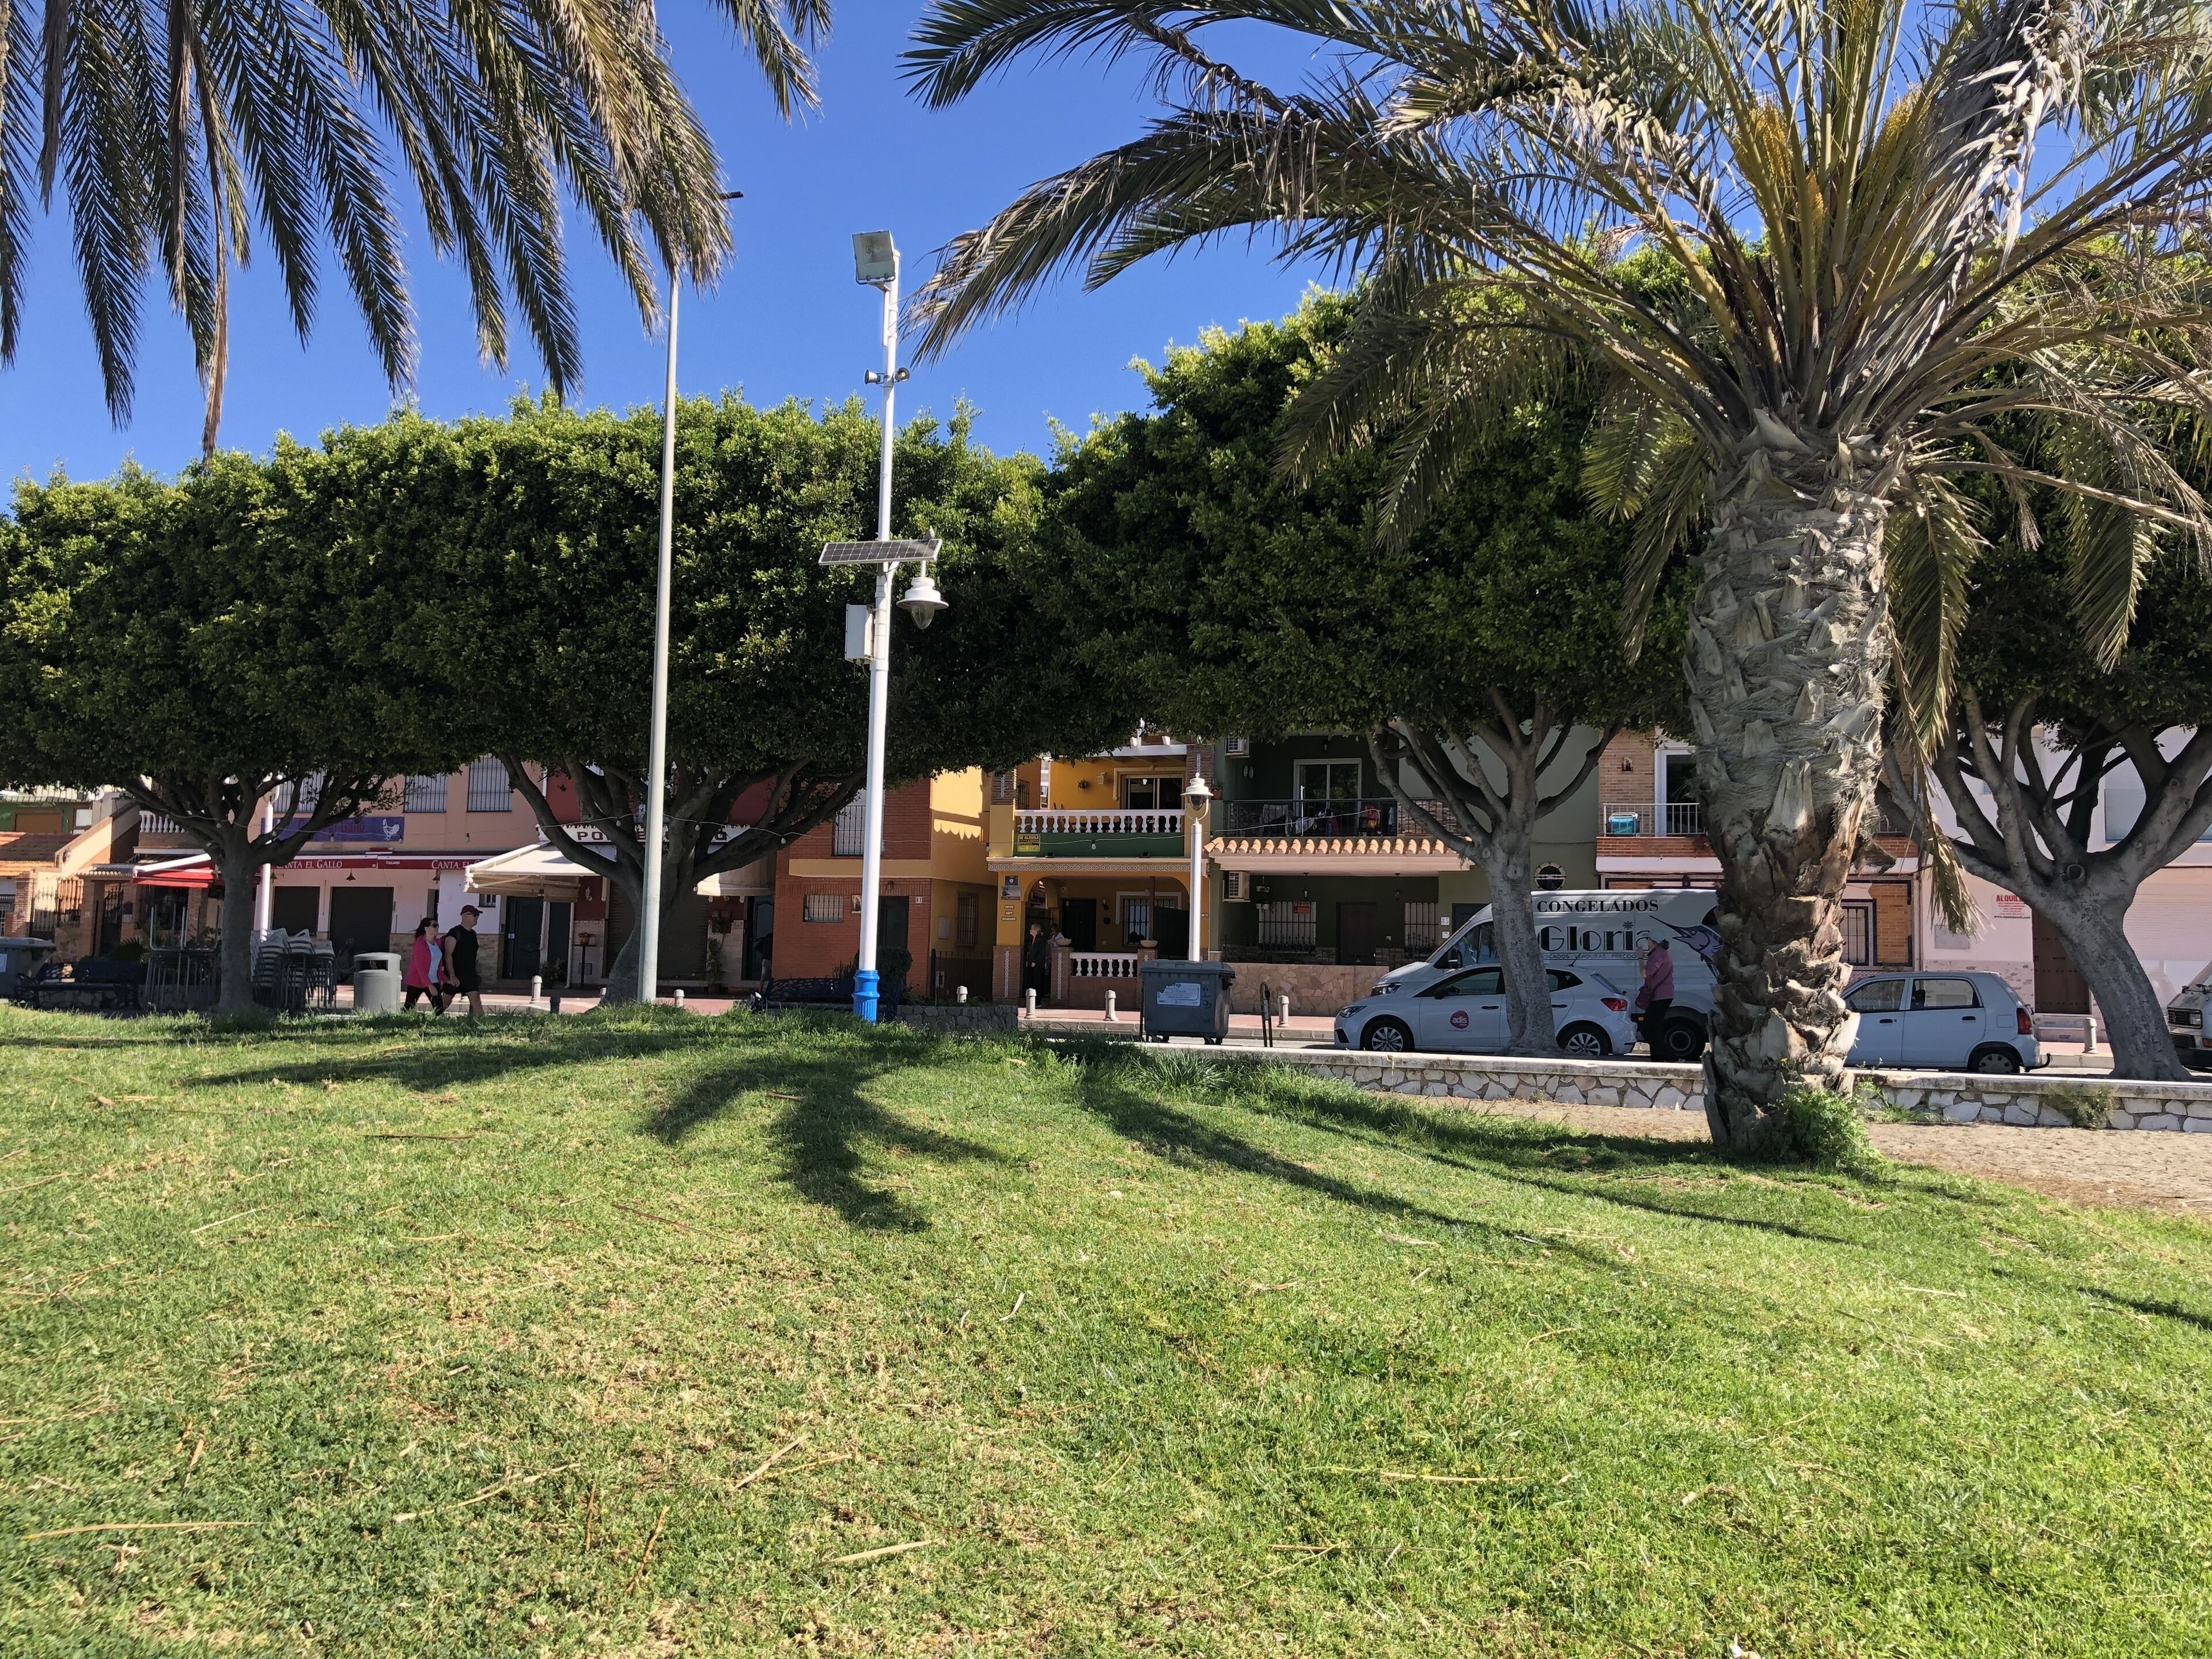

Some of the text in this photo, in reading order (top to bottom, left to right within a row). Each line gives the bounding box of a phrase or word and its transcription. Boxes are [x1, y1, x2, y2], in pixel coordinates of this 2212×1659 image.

[317, 859, 343, 869] GALLO
[432, 860, 459, 869] CANTA
[1537, 899, 1659, 912] CONGELADOS
[1537, 921, 1650, 951] Gloria
